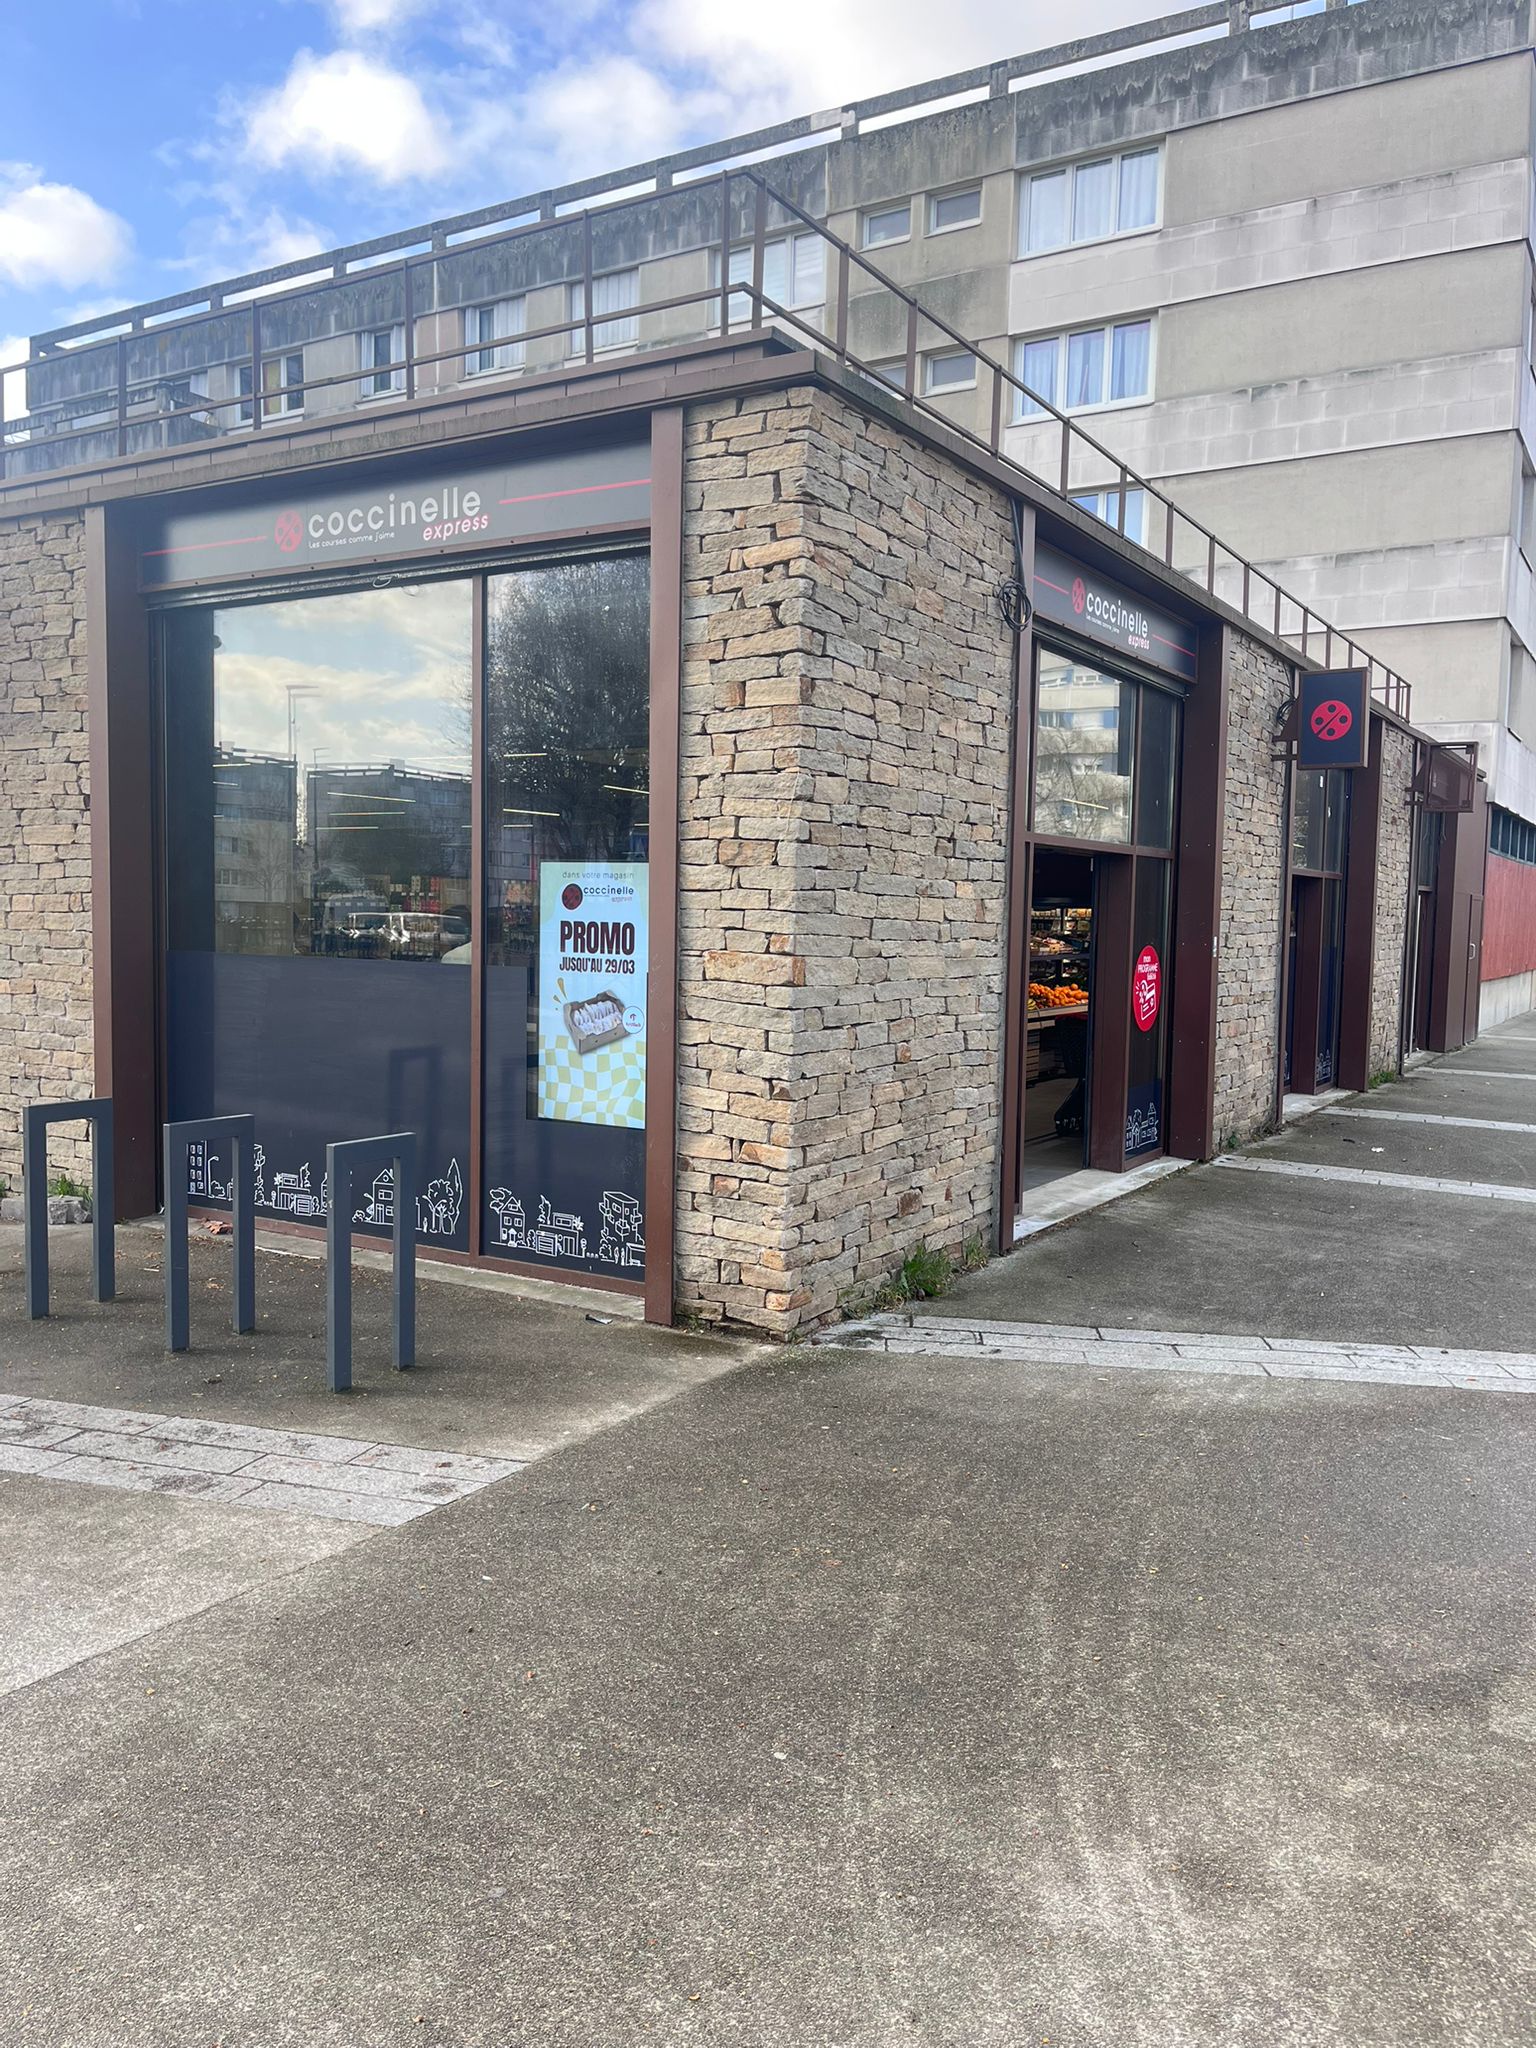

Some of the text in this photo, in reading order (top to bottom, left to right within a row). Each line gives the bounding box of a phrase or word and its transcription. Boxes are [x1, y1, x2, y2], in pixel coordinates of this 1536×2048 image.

[308, 487, 481, 538] coccinelle
[423, 514, 488, 541] express
[321, 538, 347, 547] courses
[349, 535, 373, 545] comme
[374, 531, 395, 543] j'aime
[1087, 592, 1148, 638] coccinelle
[1128, 635, 1150, 650] express
[584, 884, 634, 895] coccinelle
[560, 920, 635, 956] PROMO
[559, 956, 635, 974] JUSQU'AU 29/03
